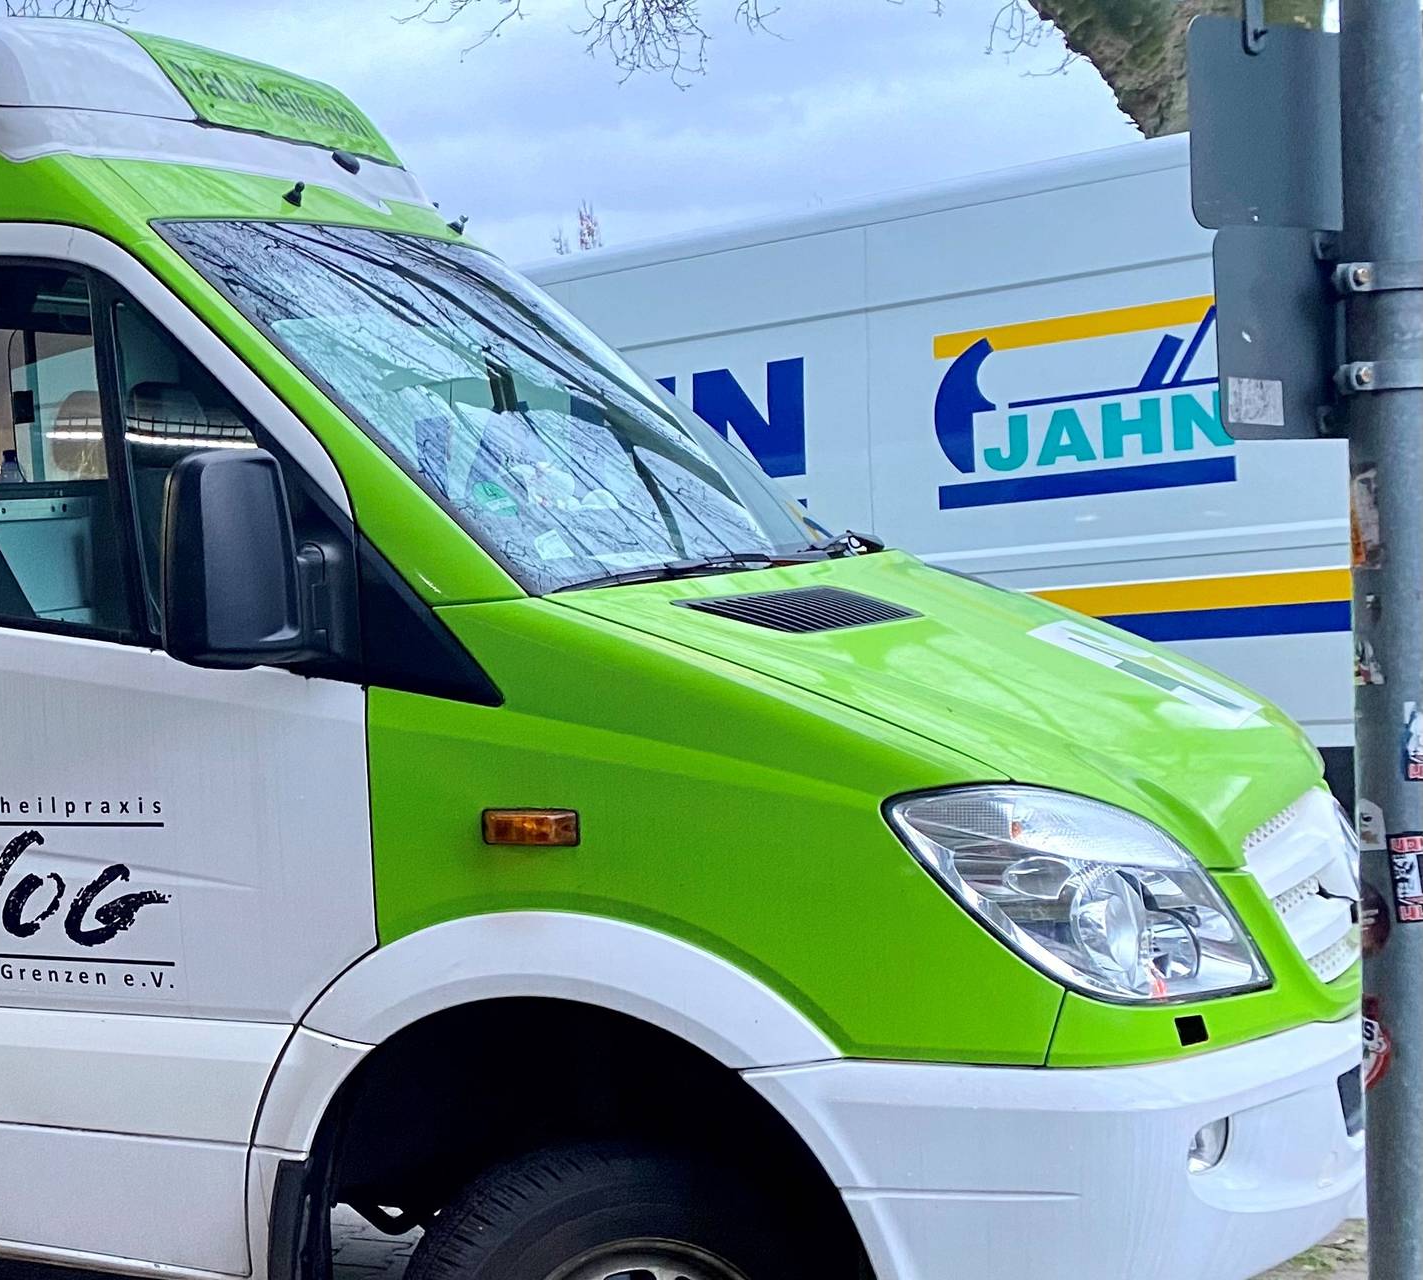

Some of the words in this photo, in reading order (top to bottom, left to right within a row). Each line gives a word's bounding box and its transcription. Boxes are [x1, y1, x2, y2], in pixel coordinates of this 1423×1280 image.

[983, 390, 1235, 472] JAHN
[1, 964, 107, 985] Grenzen
[123, 971, 175, 989] e.V.
